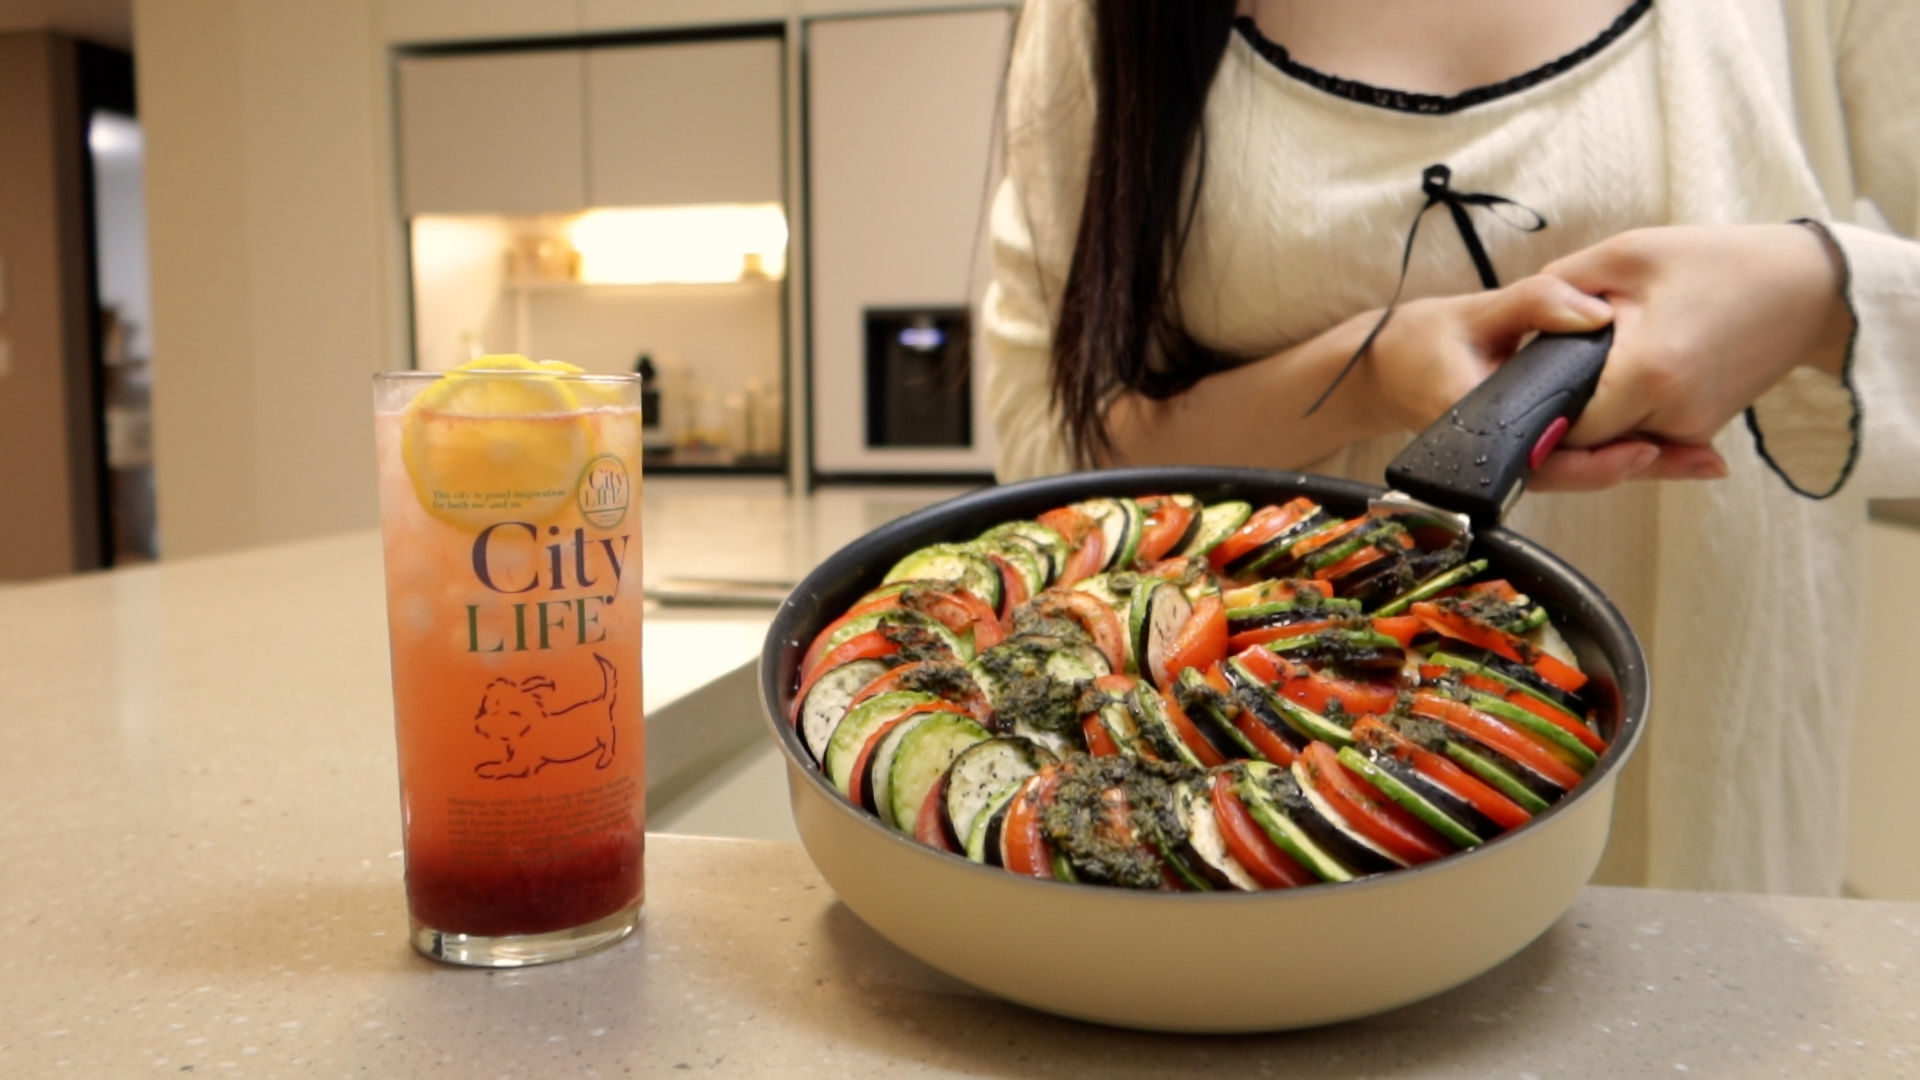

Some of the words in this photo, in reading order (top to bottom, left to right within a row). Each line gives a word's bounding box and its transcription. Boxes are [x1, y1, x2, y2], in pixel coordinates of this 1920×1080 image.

[589, 469, 624, 492] City
[433, 490, 451, 499] This
[453, 491, 470, 500] city
[473, 491, 482, 499] is
[485, 489, 511, 501] good
[488, 500, 507, 509] and
[472, 521, 631, 605] City
[466, 595, 607, 652] LIFE
